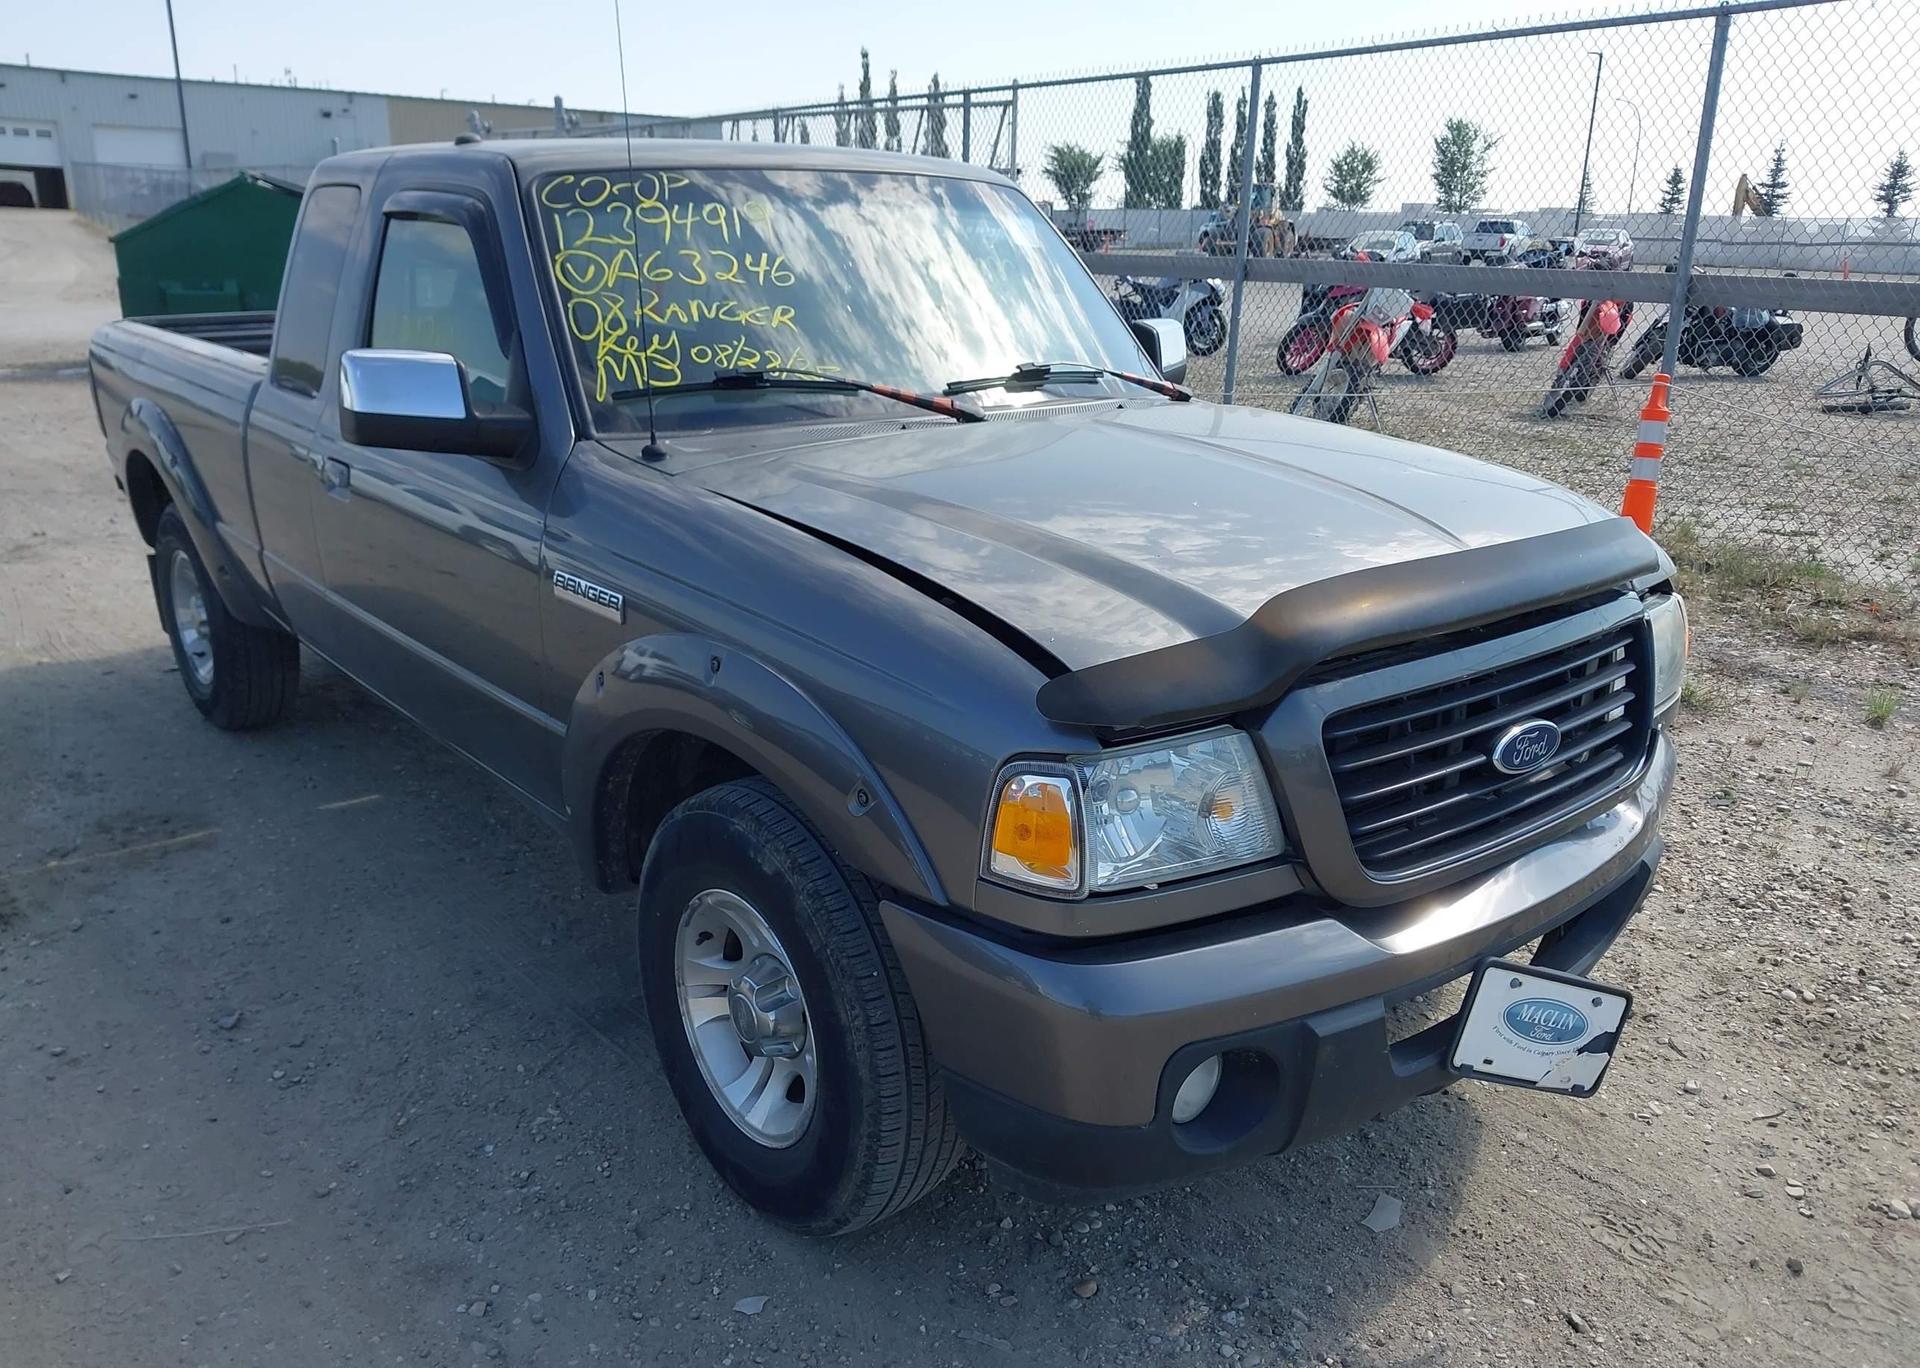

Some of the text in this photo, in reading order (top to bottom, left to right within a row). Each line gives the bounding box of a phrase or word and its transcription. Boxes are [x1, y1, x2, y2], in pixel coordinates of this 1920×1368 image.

[634, 288, 798, 332] RANGER
[554, 572, 620, 612] RANGER
[1512, 730, 1550, 766] Ford
[1516, 1004, 1578, 1031] MACLIN
[1529, 1024, 1555, 1041] Ford
